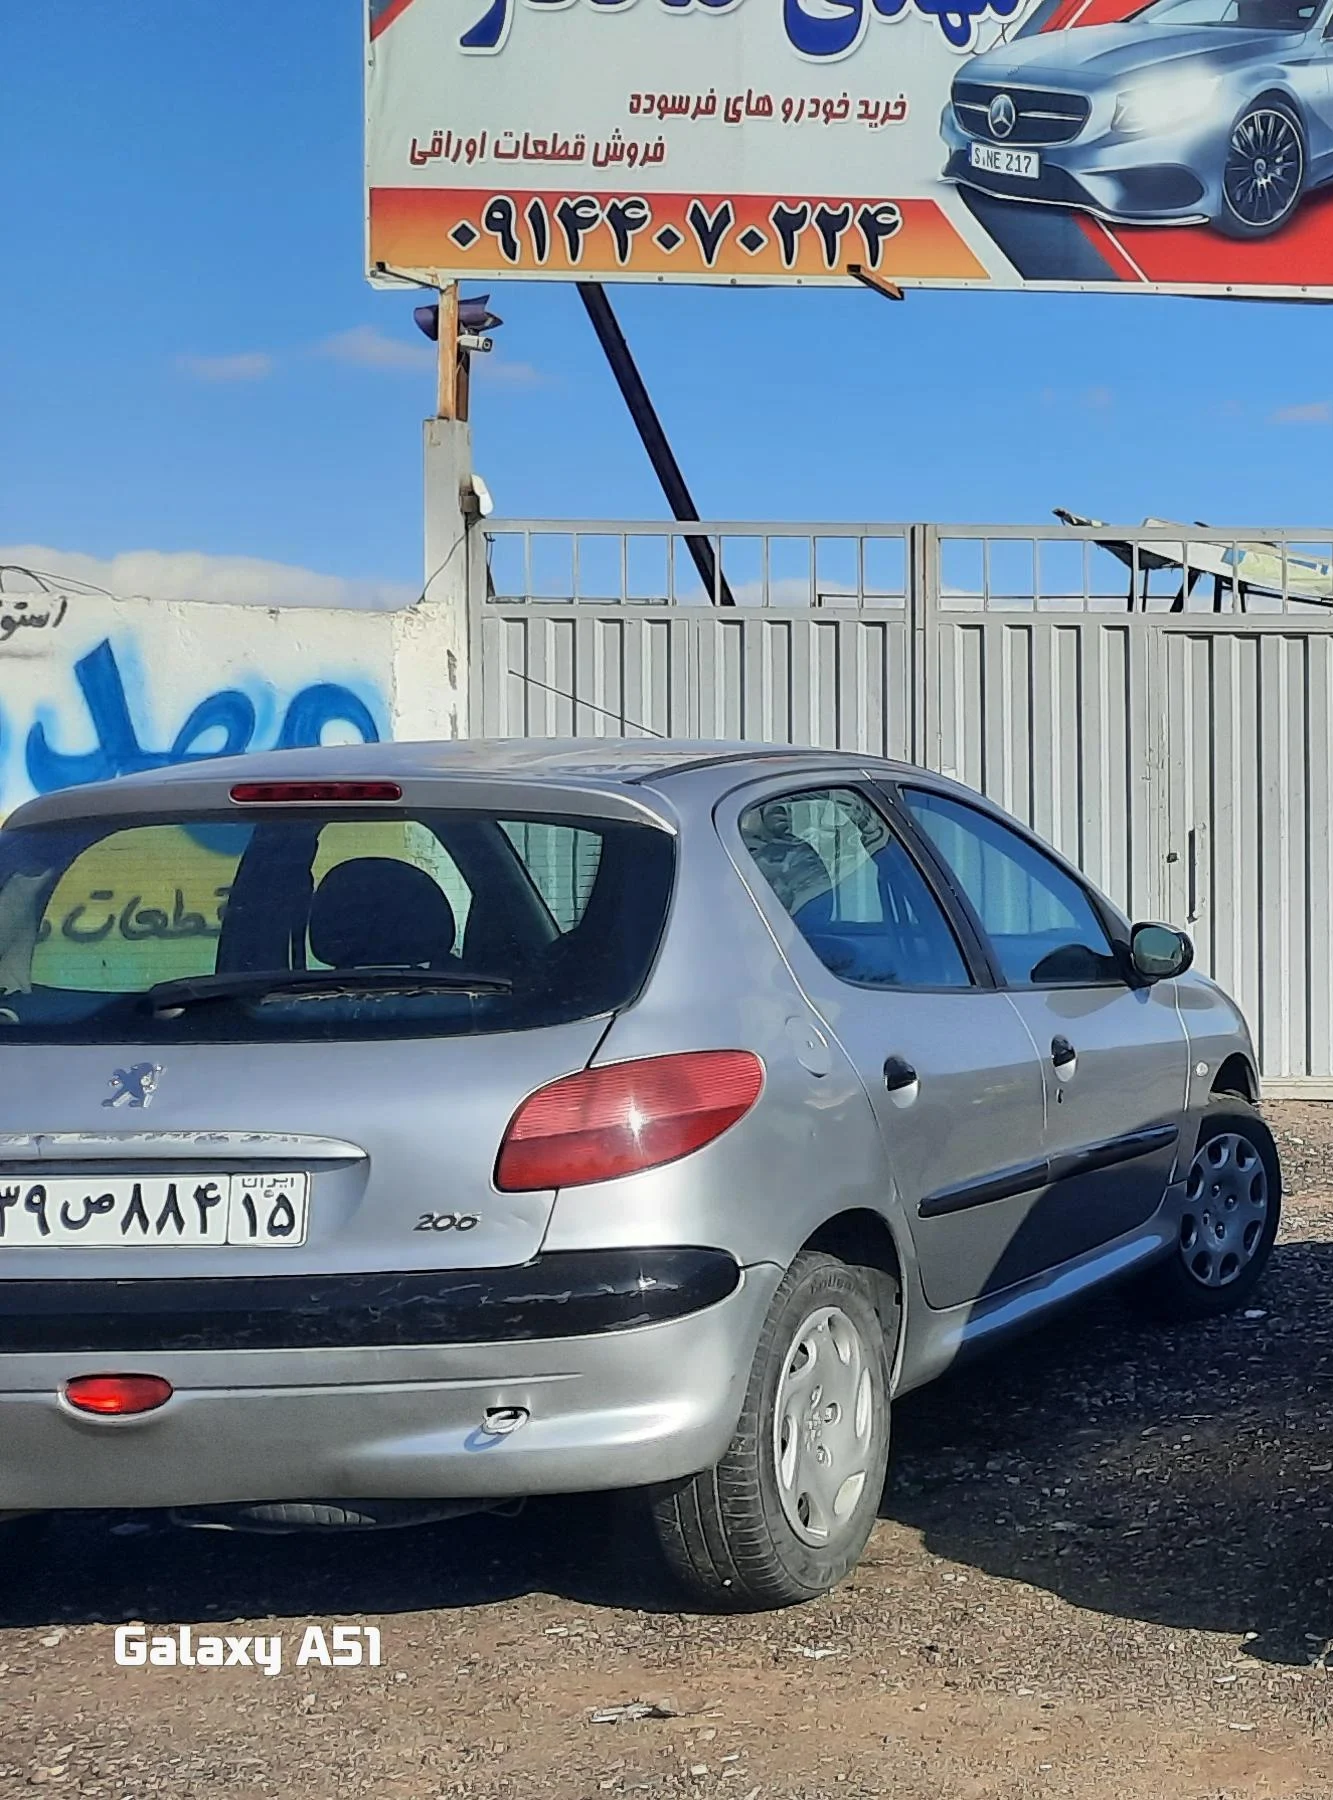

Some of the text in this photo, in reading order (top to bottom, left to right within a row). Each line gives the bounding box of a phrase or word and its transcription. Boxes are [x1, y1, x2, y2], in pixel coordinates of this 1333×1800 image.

[629, 90, 907, 129] خرید خودرو های فرسوده
[409, 127, 666, 168] فروش قطعات اوراقی
[1005, 150, 1032, 174] 217
[450, 195, 901, 266] ۰۹۱۴۴۰۷۰۲۲۴
[241, 1176, 295, 1189] ایران
[242, 1192, 296, 1238] ۱۵
